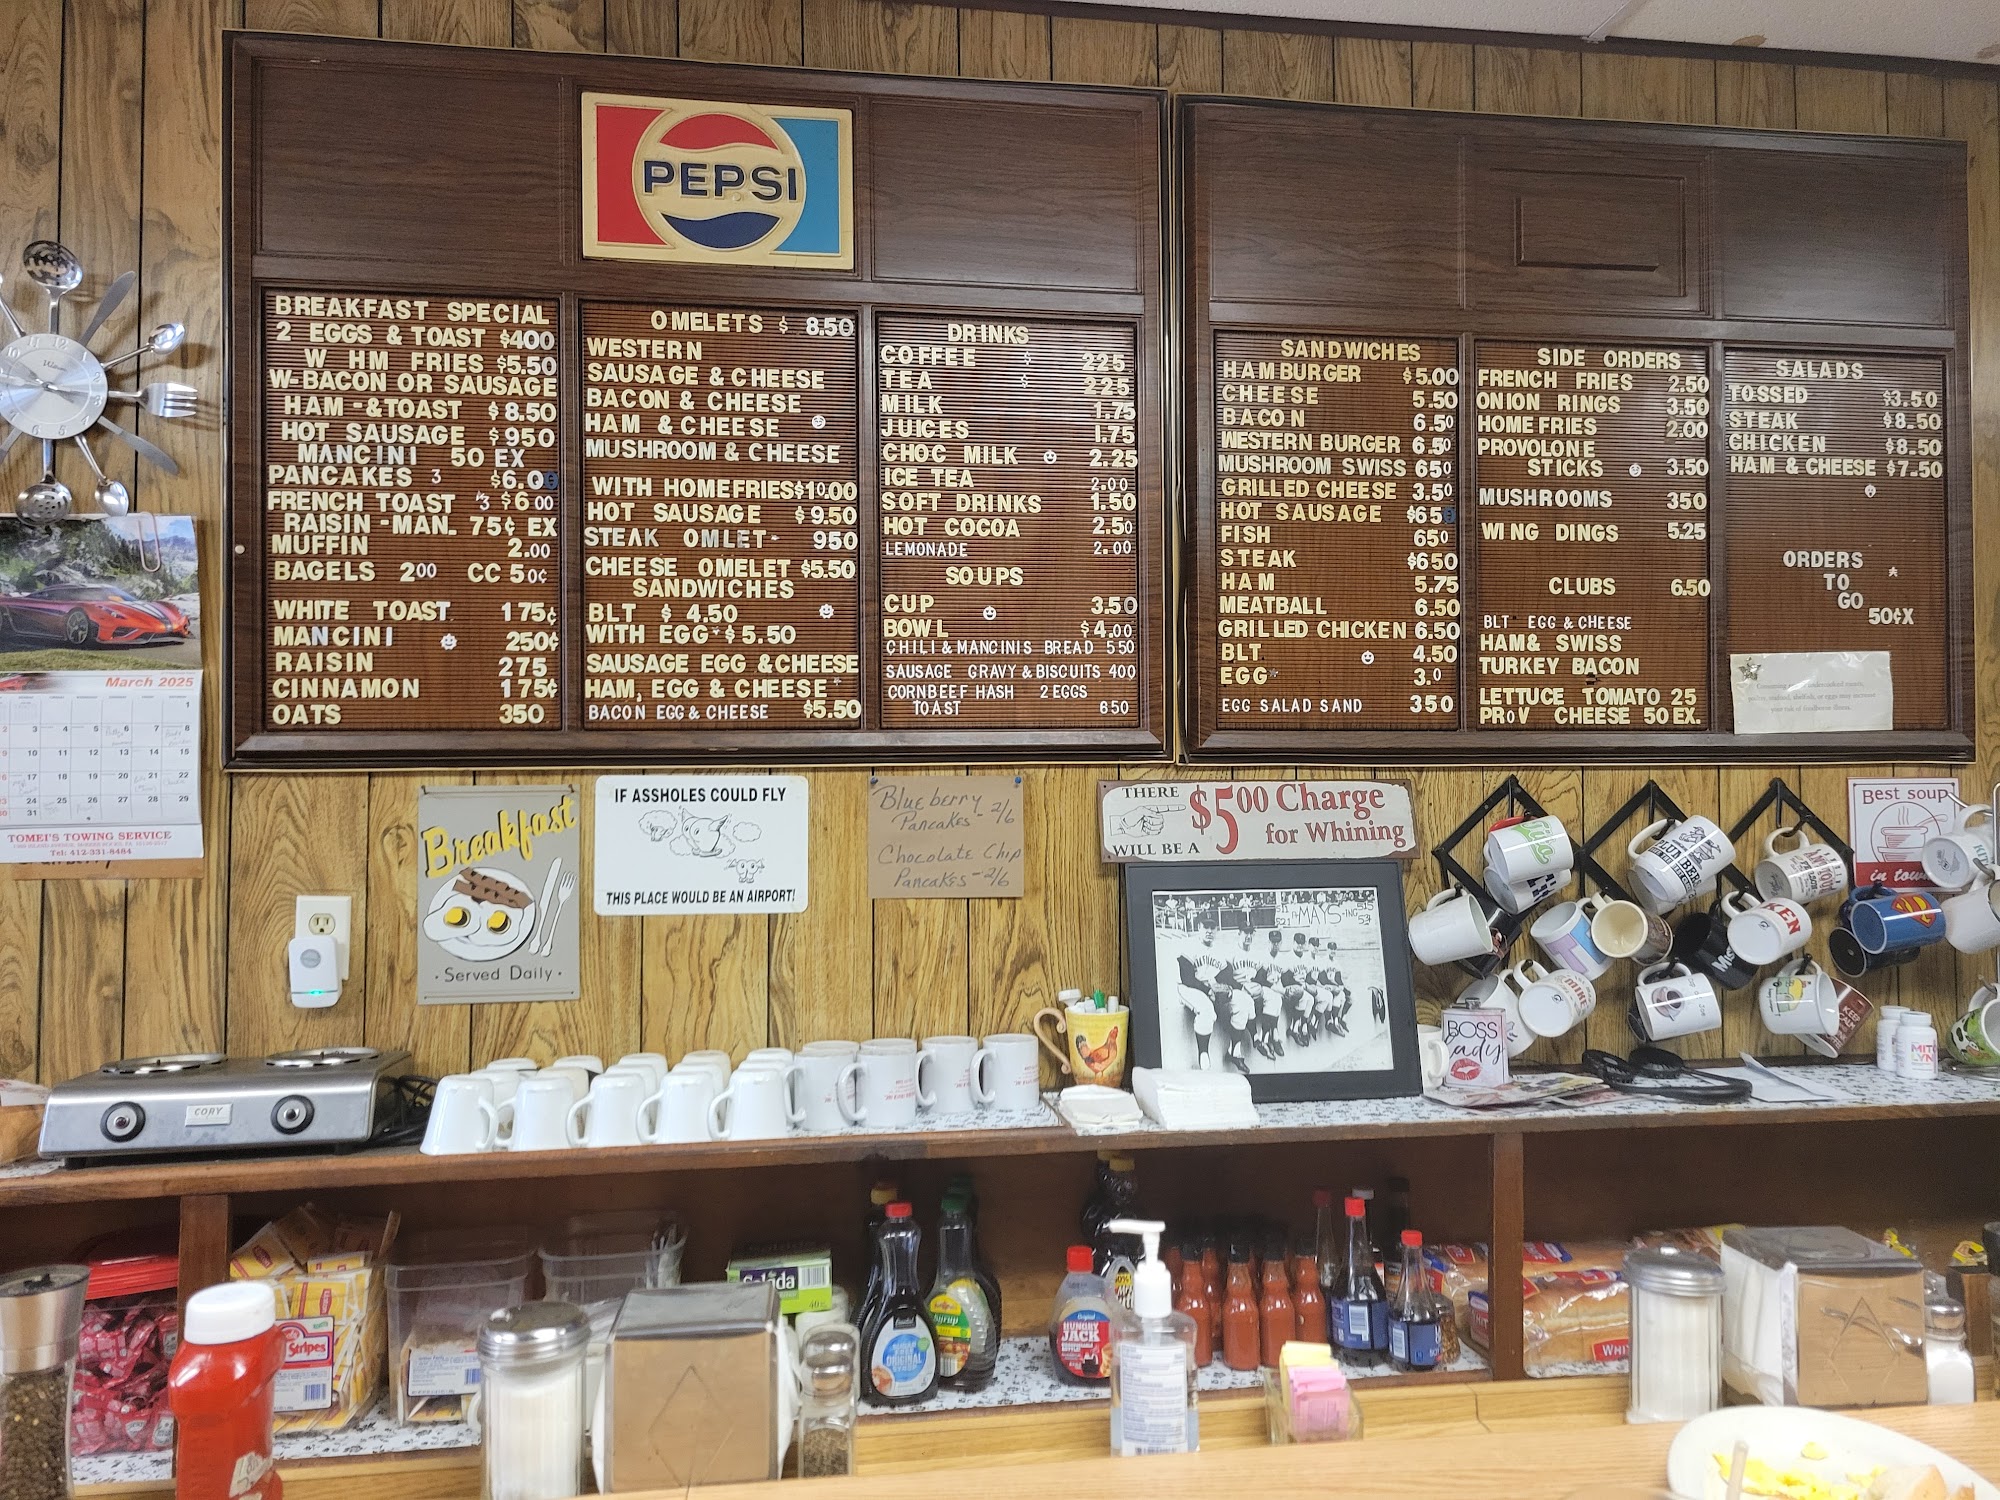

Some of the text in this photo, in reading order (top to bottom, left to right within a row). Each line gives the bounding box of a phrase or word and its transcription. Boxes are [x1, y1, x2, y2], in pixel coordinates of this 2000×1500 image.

[644, 161, 797, 200] PEPSI
[276, 295, 550, 325] BREAKFAST SPECIAL
[651, 311, 763, 333] OMELETS
[276, 321, 555, 350] 2 EGGS & TOAST $400
[948, 324, 1029, 344] DRINKS
[586, 337, 702, 360] WESTERN
[1280, 340, 1421, 361] SANDWICHES
[1538, 348, 1681, 370] SIDE ORDERS
[588, 363, 825, 389] SAUSAGE & CHEESE
[1223, 361, 1361, 383] HAMBURGER
[1776, 360, 1863, 379] SALADS
[398, 372, 433, 392] OR
[444, 376, 558, 397] SAUSAGE
[1479, 370, 1633, 390] FRENCH FRIES
[1728, 385, 1937, 407] TOSSED $3.50
[298, 444, 525, 468] MANCINI 50 EX
[883, 443, 1138, 468] CHOC MILK 2.25
[1730, 456, 1876, 476] HAM & CHEESE
[885, 541, 1132, 557] LEMONADE 2.00
[586, 557, 855, 578] CHEESE OMELET $5.50
[1783, 551, 1863, 568] ORDERS
[945, 567, 1024, 585] SOUPS
[1824, 574, 1849, 590] TO
[1837, 592, 1863, 609] GO
[1218, 621, 1460, 639] GRILLED CHICKEN 6.50
[1484, 616, 1632, 630] BLT EGG & CHEESE
[886, 640, 1135, 655] CHILI & MANCINIS BREAD 550
[886, 664, 1136, 680] SAUSAGE GRAVY & BISCUITS 400
[106, 677, 194, 687] March 2025
[1222, 696, 1454, 713] EGG SALAD SAND 350
[1480, 688, 1696, 706] LETTUCE TOMATO 25
[272, 704, 544, 724] OATS 350
[589, 705, 769, 720] BACON EGG & CHEESE
[615, 787, 786, 803] IF ASSHOLES COULD FLY
[1122, 786, 1180, 798] THERE
[1863, 788, 1948, 804] Best soup
[1276, 783, 1386, 820] Charge
[8, 831, 172, 843] TOMEI'S TOWING SERVICE
[422, 795, 577, 879] Breakfast
[1266, 822, 1404, 848] for Whining
[70, 848, 132, 856] 412-331-8484
[878, 842, 1021, 864] Chocolate Chip
[1113, 842, 1200, 857] WILL BE A
[1870, 870, 1887, 881] in
[607, 889, 795, 905] THIS PLACE WOULD BE AN AIRPORT!
[1763, 902, 1801, 936] KEN
[445, 965, 553, 982] Served Daily
[1448, 1021, 1497, 1039] BOSS
[194, 1106, 224, 1118] CORY
[1063, 1322, 1099, 1331] HUNGRY
[1062, 1330, 1100, 1342] JACK
[289, 1342, 325, 1357] Stripes
